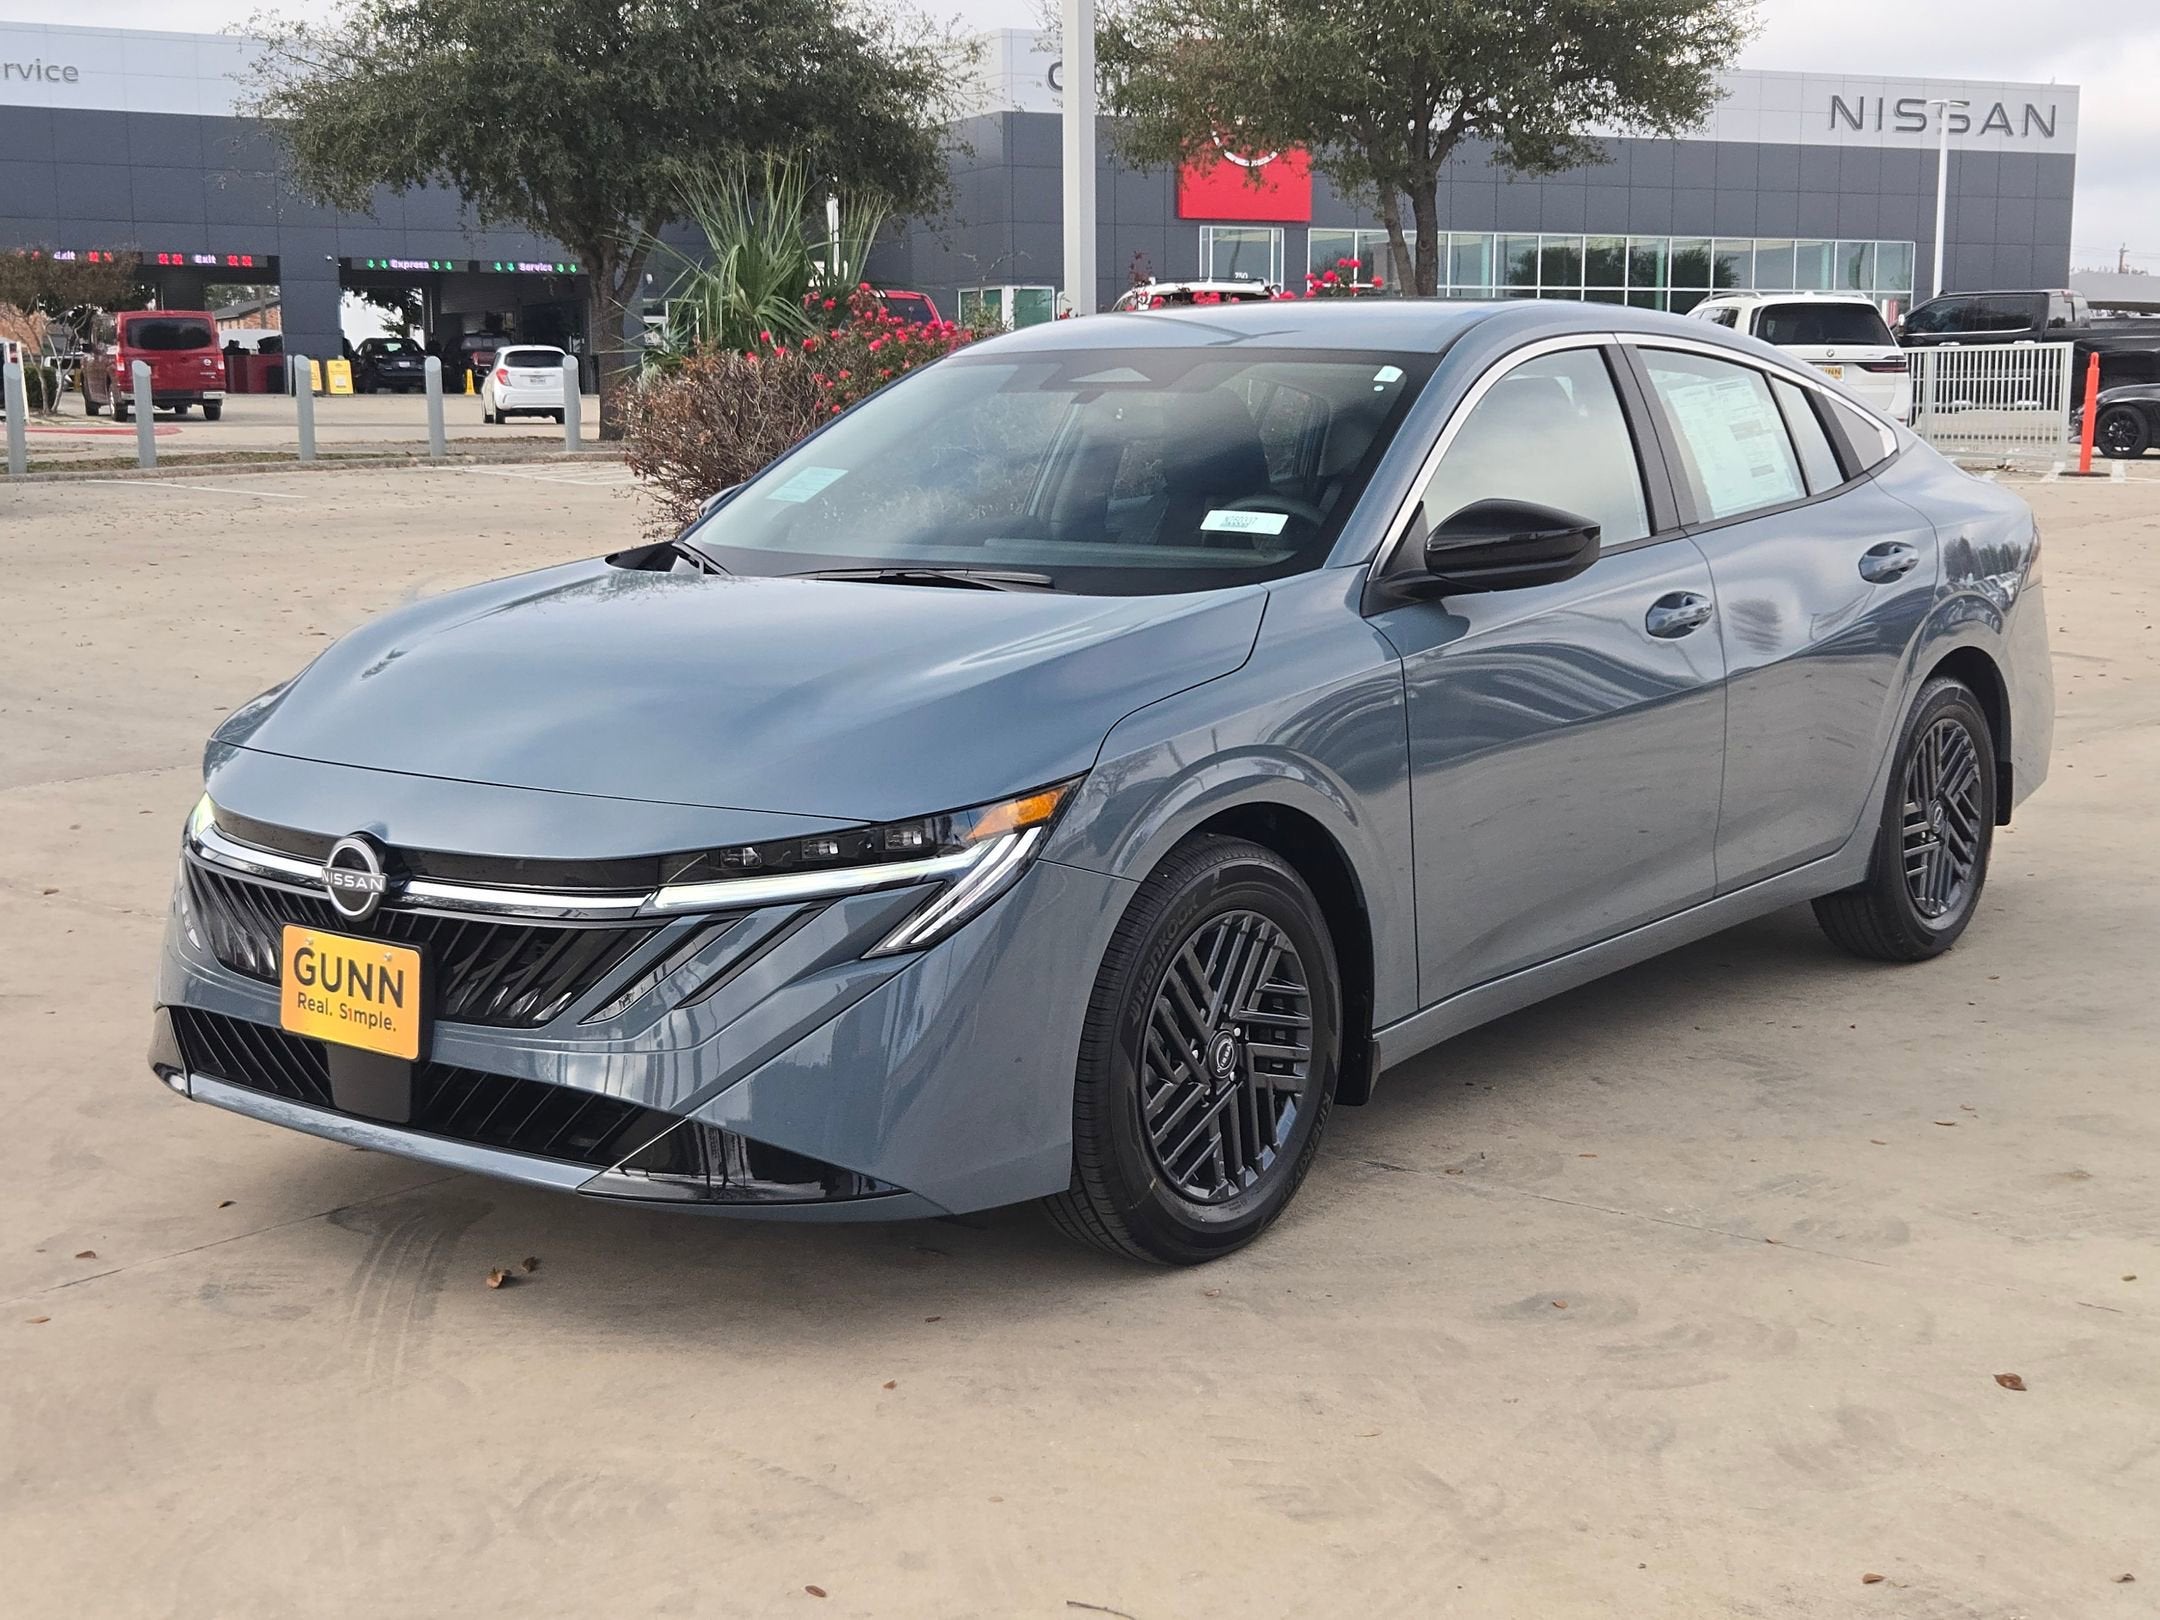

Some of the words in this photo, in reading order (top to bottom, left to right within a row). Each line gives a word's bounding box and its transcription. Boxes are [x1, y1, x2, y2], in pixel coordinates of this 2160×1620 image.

[1828, 95, 2056, 138] NISSAN
[194, 254, 217, 264] Exit
[391, 259, 429, 270] Express
[519, 262, 553, 272] Service
[322, 869, 383, 890] NISSAN
[293, 946, 404, 1009] GUNN
[297, 991, 333, 1016] Real.
